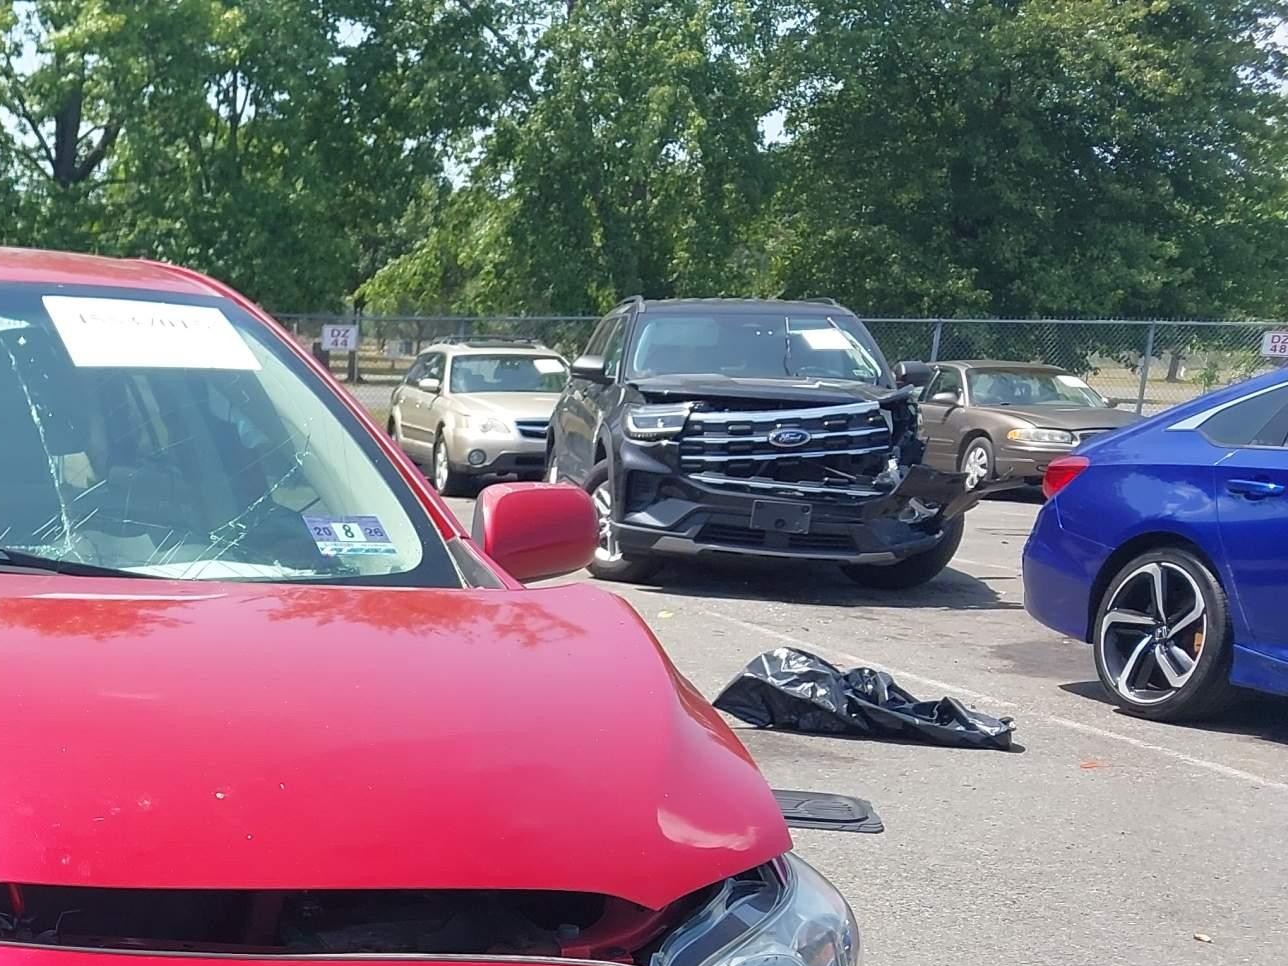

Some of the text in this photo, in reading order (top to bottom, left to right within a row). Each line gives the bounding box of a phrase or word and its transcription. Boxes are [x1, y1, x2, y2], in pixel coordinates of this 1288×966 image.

[1270, 345, 1287, 353] 48
[314, 523, 384, 539] 20 8 26
